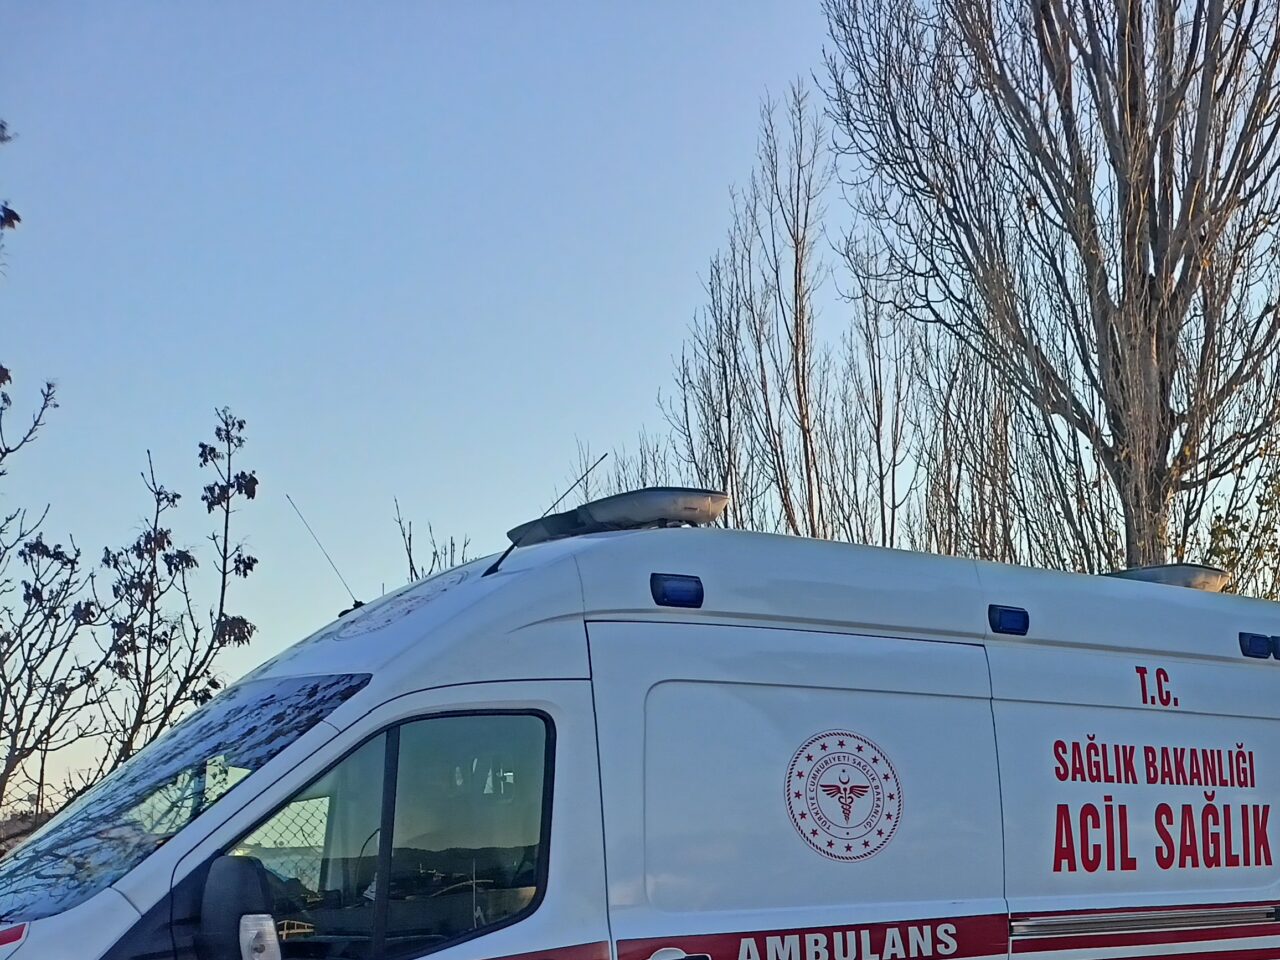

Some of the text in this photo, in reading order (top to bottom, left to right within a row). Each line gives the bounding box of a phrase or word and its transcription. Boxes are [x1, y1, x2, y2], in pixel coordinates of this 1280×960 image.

[1135, 666, 1179, 707] T.C.
[1053, 734, 1255, 788] SAĞLIK BAKANLIĞI
[1053, 790, 1273, 873] ACİL SAĞLIK
